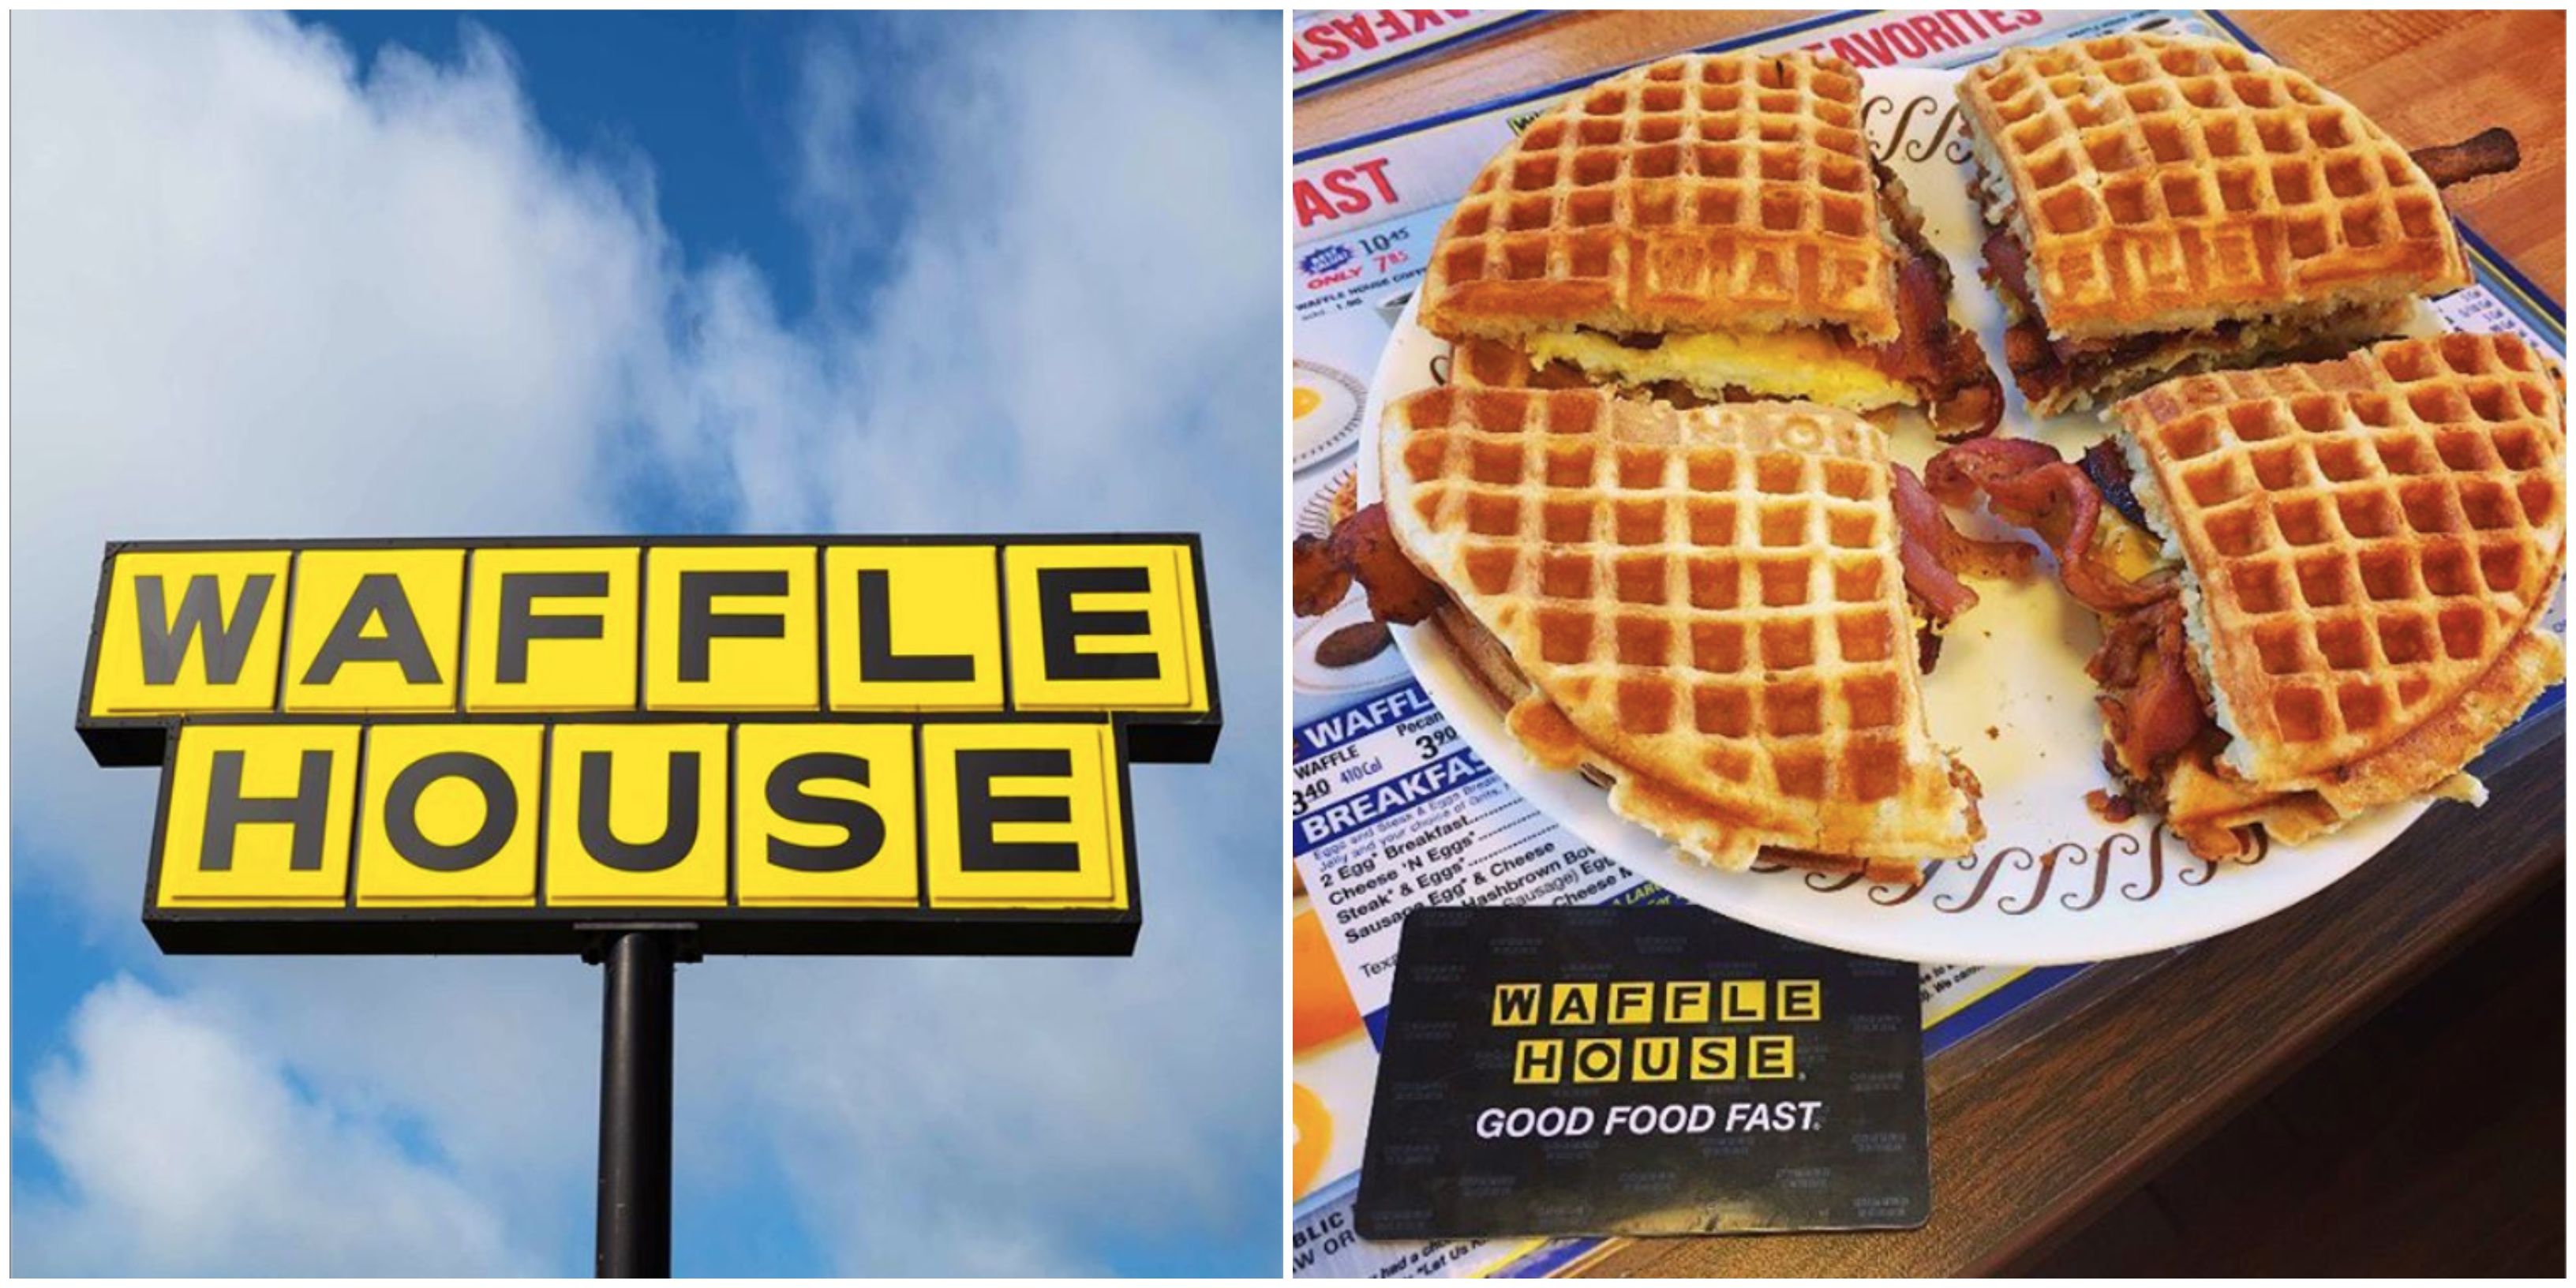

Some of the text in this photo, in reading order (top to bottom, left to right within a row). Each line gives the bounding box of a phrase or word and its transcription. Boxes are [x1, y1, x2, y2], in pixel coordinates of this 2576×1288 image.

[1798, 9, 2043, 68] AVORITES
[1293, 158, 1399, 227] AST
[1307, 265, 1363, 290] ONLY
[133, 565, 1162, 687] WAFFLE
[1304, 687, 1432, 749] WAFFL
[1395, 710, 1446, 736] Pecan
[1294, 744, 1359, 780] WAFFLE
[197, 747, 1081, 874] HOUSE
[1301, 750, 1490, 843] BREAKFAS
[1320, 873, 1334, 888] 2
[1473, 872, 1487, 886] &
[1490, 841, 1556, 877] Cheese
[1328, 870, 1398, 905] Cheese
[1399, 882, 1413, 897] &
[1499, 984, 1813, 1020] WAFFLE
[1521, 1039, 1786, 1079] HOUSE
[1477, 1106, 1594, 1139] GOOD
[1604, 1104, 1716, 1136] FOOD
[1293, 1211, 1344, 1249] BLIC
[1323, 1229, 1356, 1255] OR
